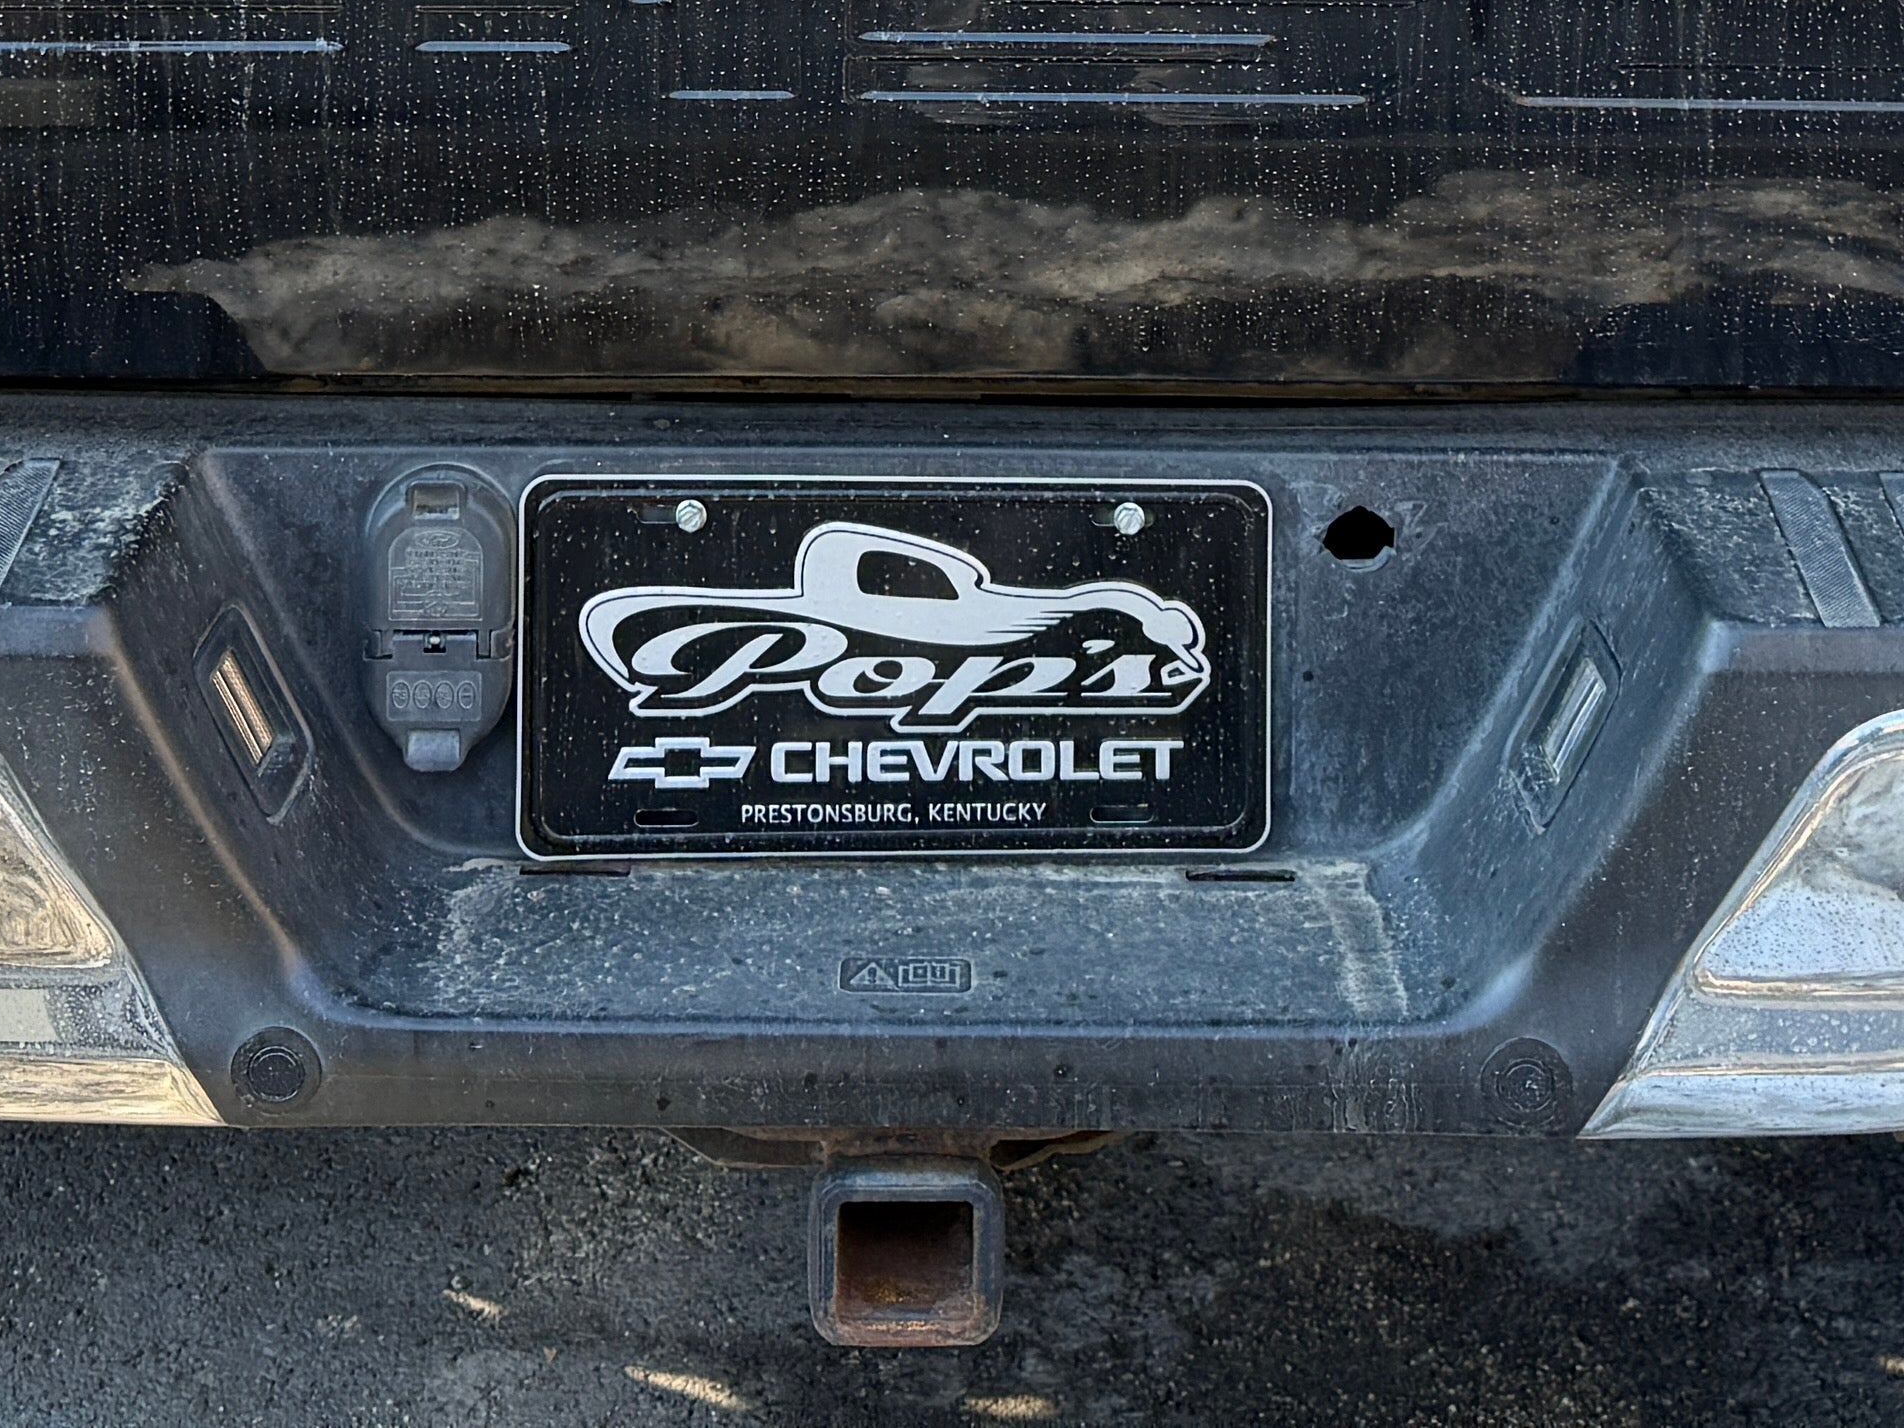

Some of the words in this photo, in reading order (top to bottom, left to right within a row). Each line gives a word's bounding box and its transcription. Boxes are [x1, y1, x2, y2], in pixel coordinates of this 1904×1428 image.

[631, 621, 1177, 715] Pop's
[770, 740, 1184, 784] CHEVROLET
[740, 803, 919, 825] PRESTONSBURG,
[929, 801, 1046, 822] KENTUCKY
